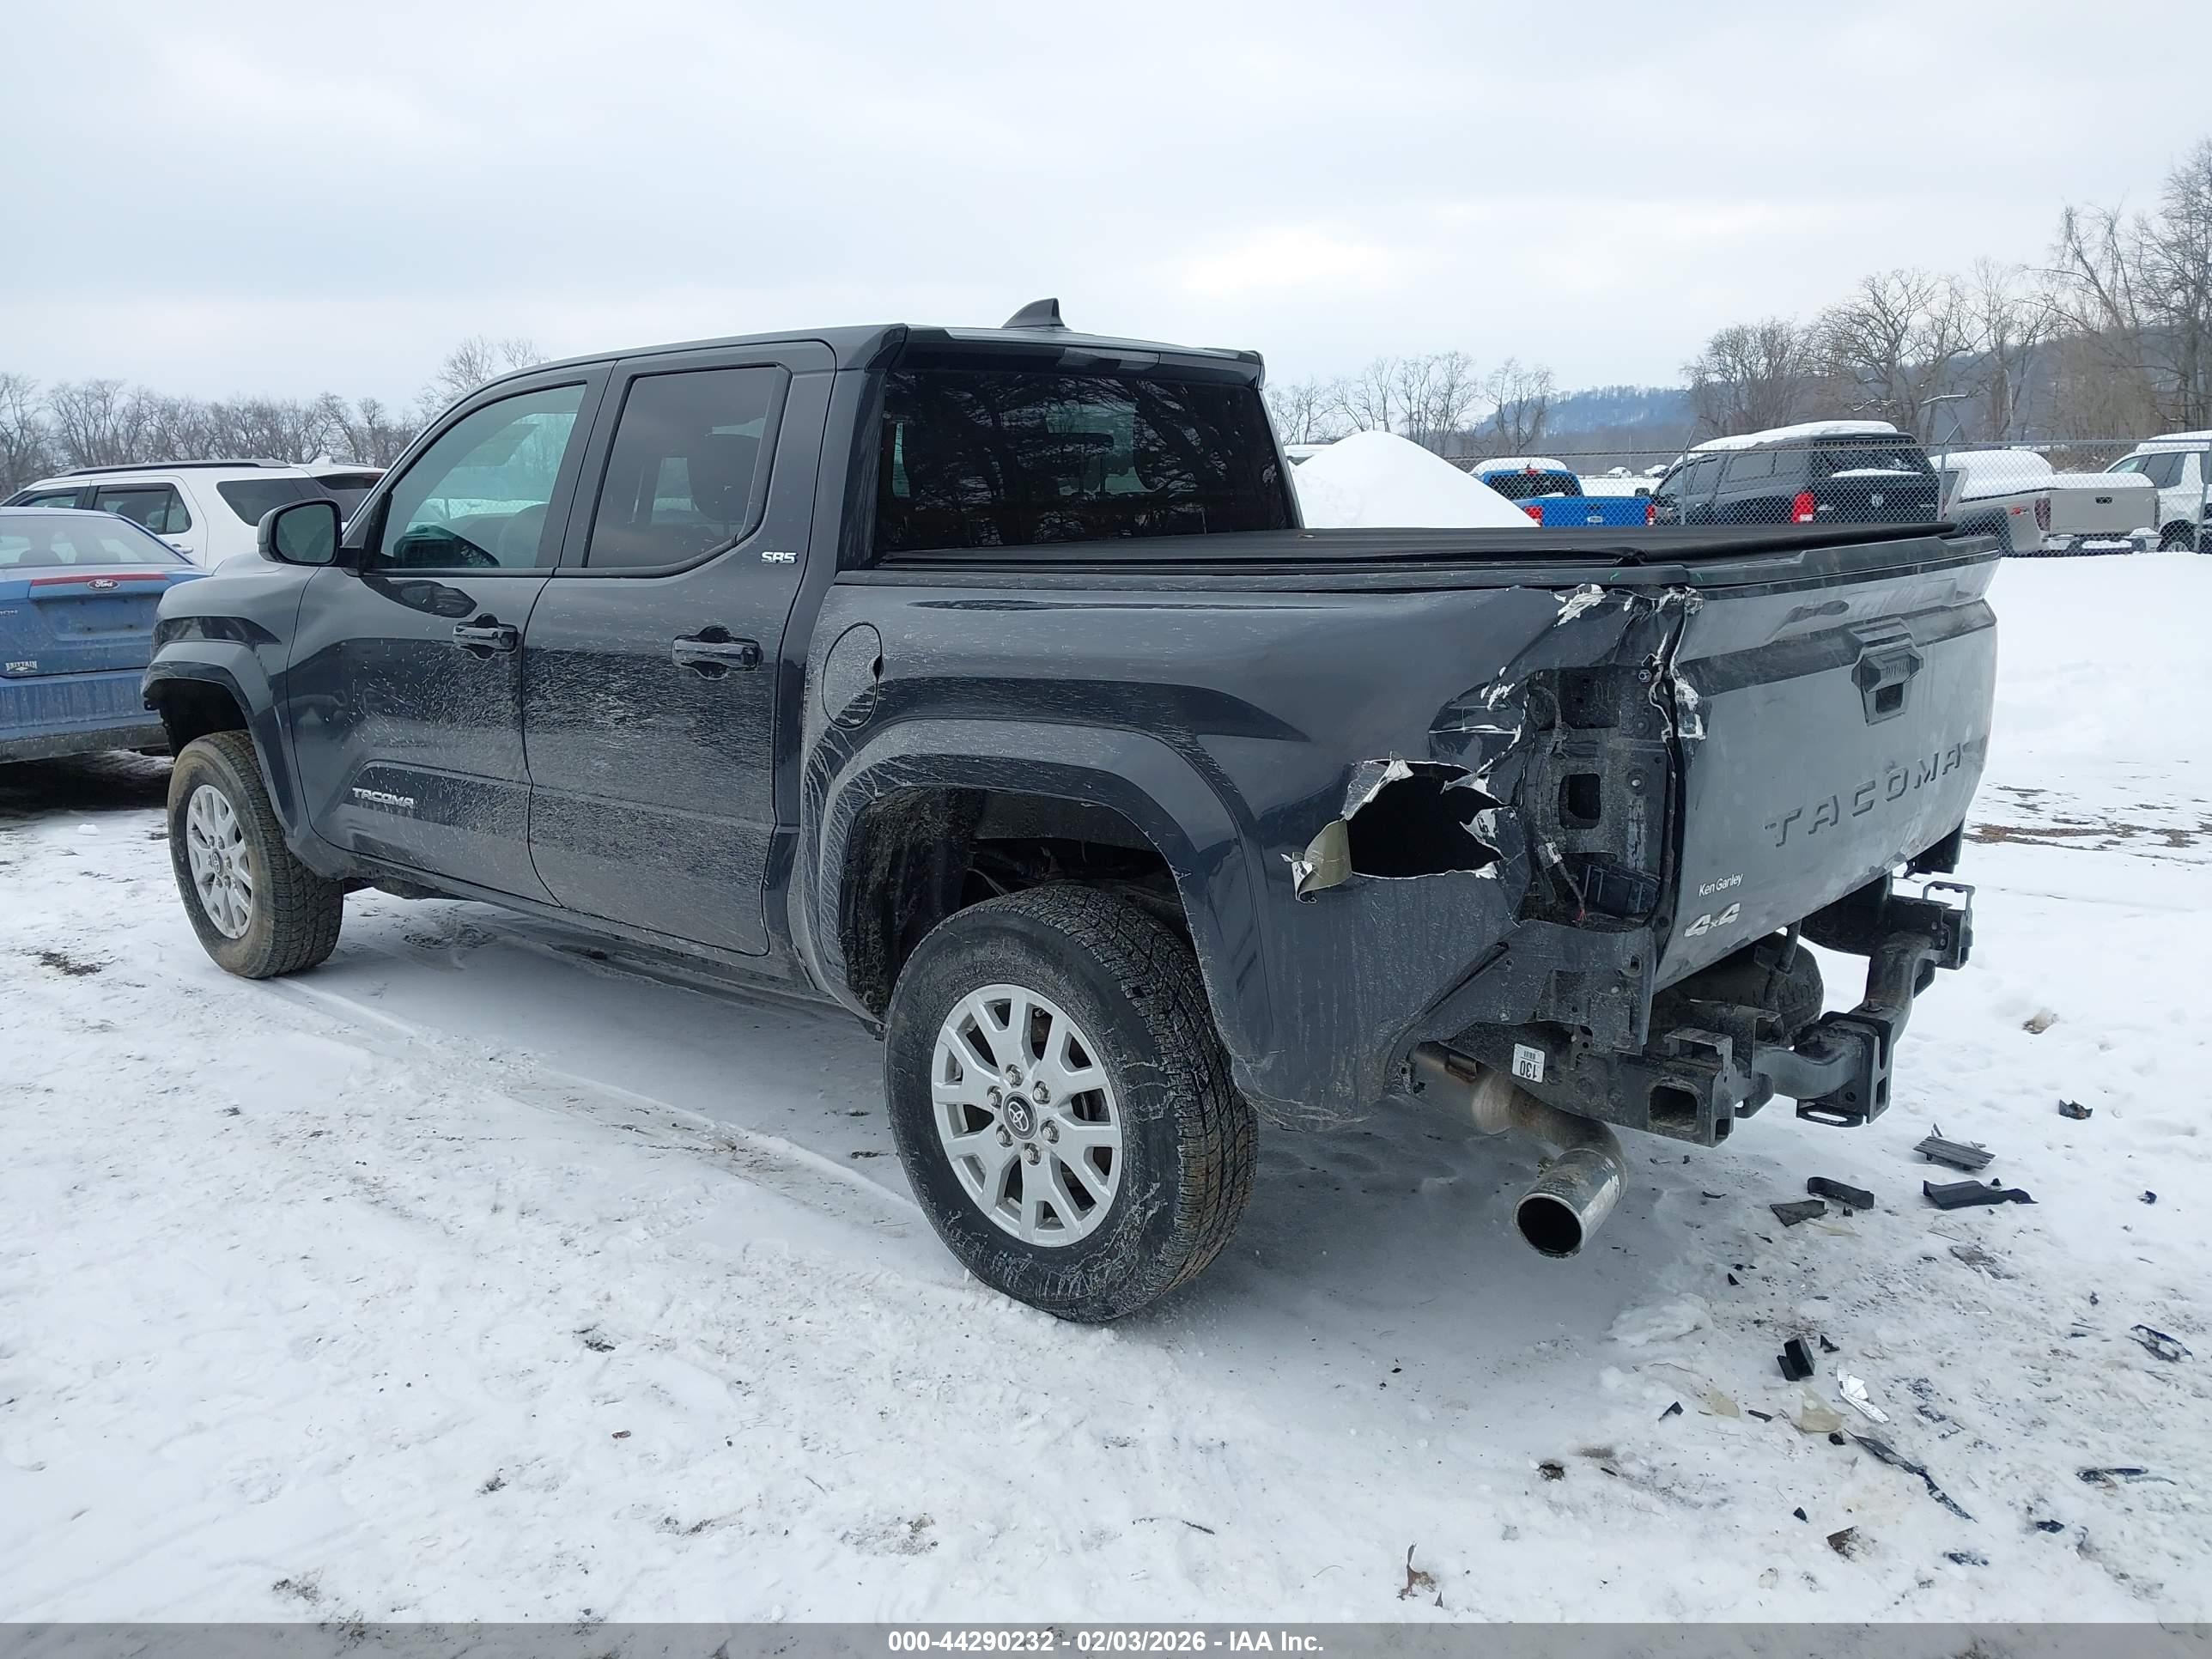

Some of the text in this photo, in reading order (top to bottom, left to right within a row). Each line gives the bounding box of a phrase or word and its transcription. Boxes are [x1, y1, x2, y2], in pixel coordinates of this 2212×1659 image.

[761, 551, 797, 564] SR5
[352, 787, 415, 808] TACOMA
[1764, 742, 1963, 848] TACOMA
[1698, 872, 1744, 897] Ken Ganley
[1519, 1060, 1538, 1079] 130
